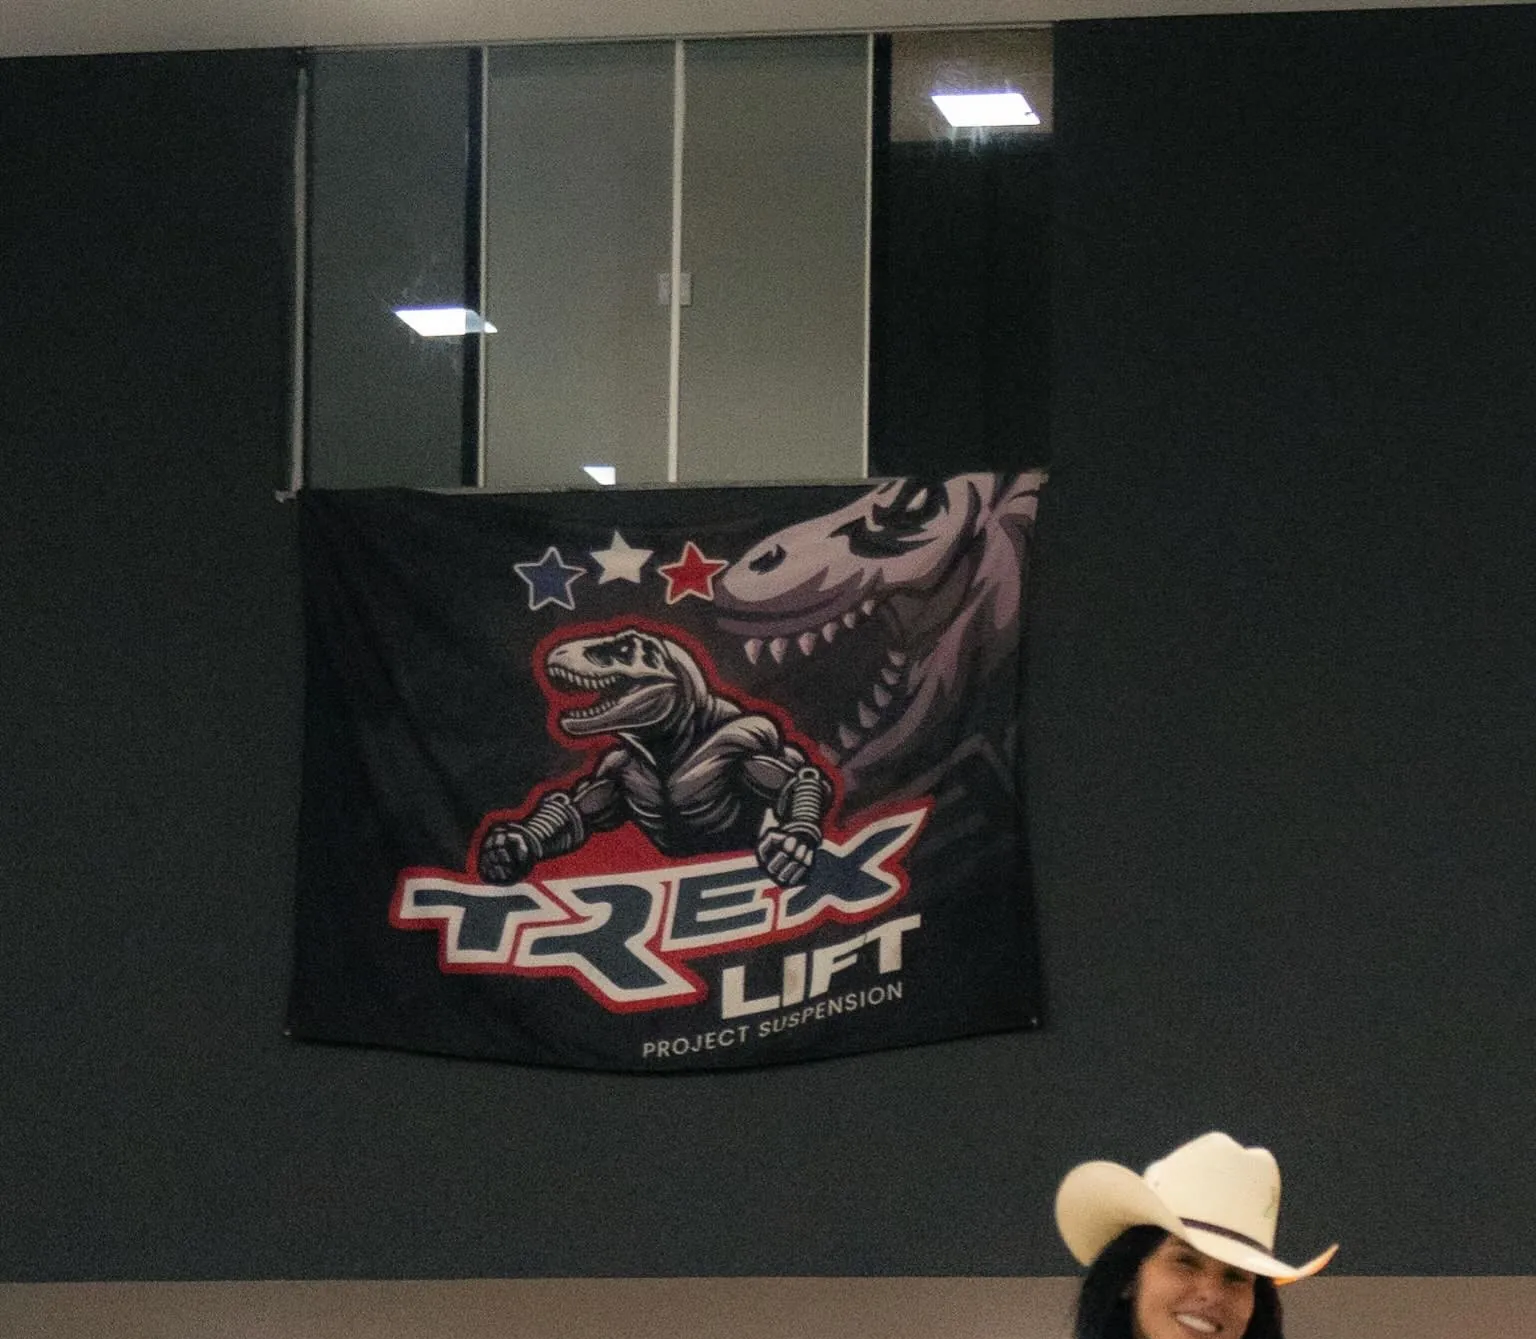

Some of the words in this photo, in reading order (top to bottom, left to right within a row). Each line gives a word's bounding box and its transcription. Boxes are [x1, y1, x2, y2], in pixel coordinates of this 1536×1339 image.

[721, 914, 922, 1020] LIFT
[642, 1025, 750, 1059] PROJECT
[758, 981, 903, 1038] SUSPENSION
